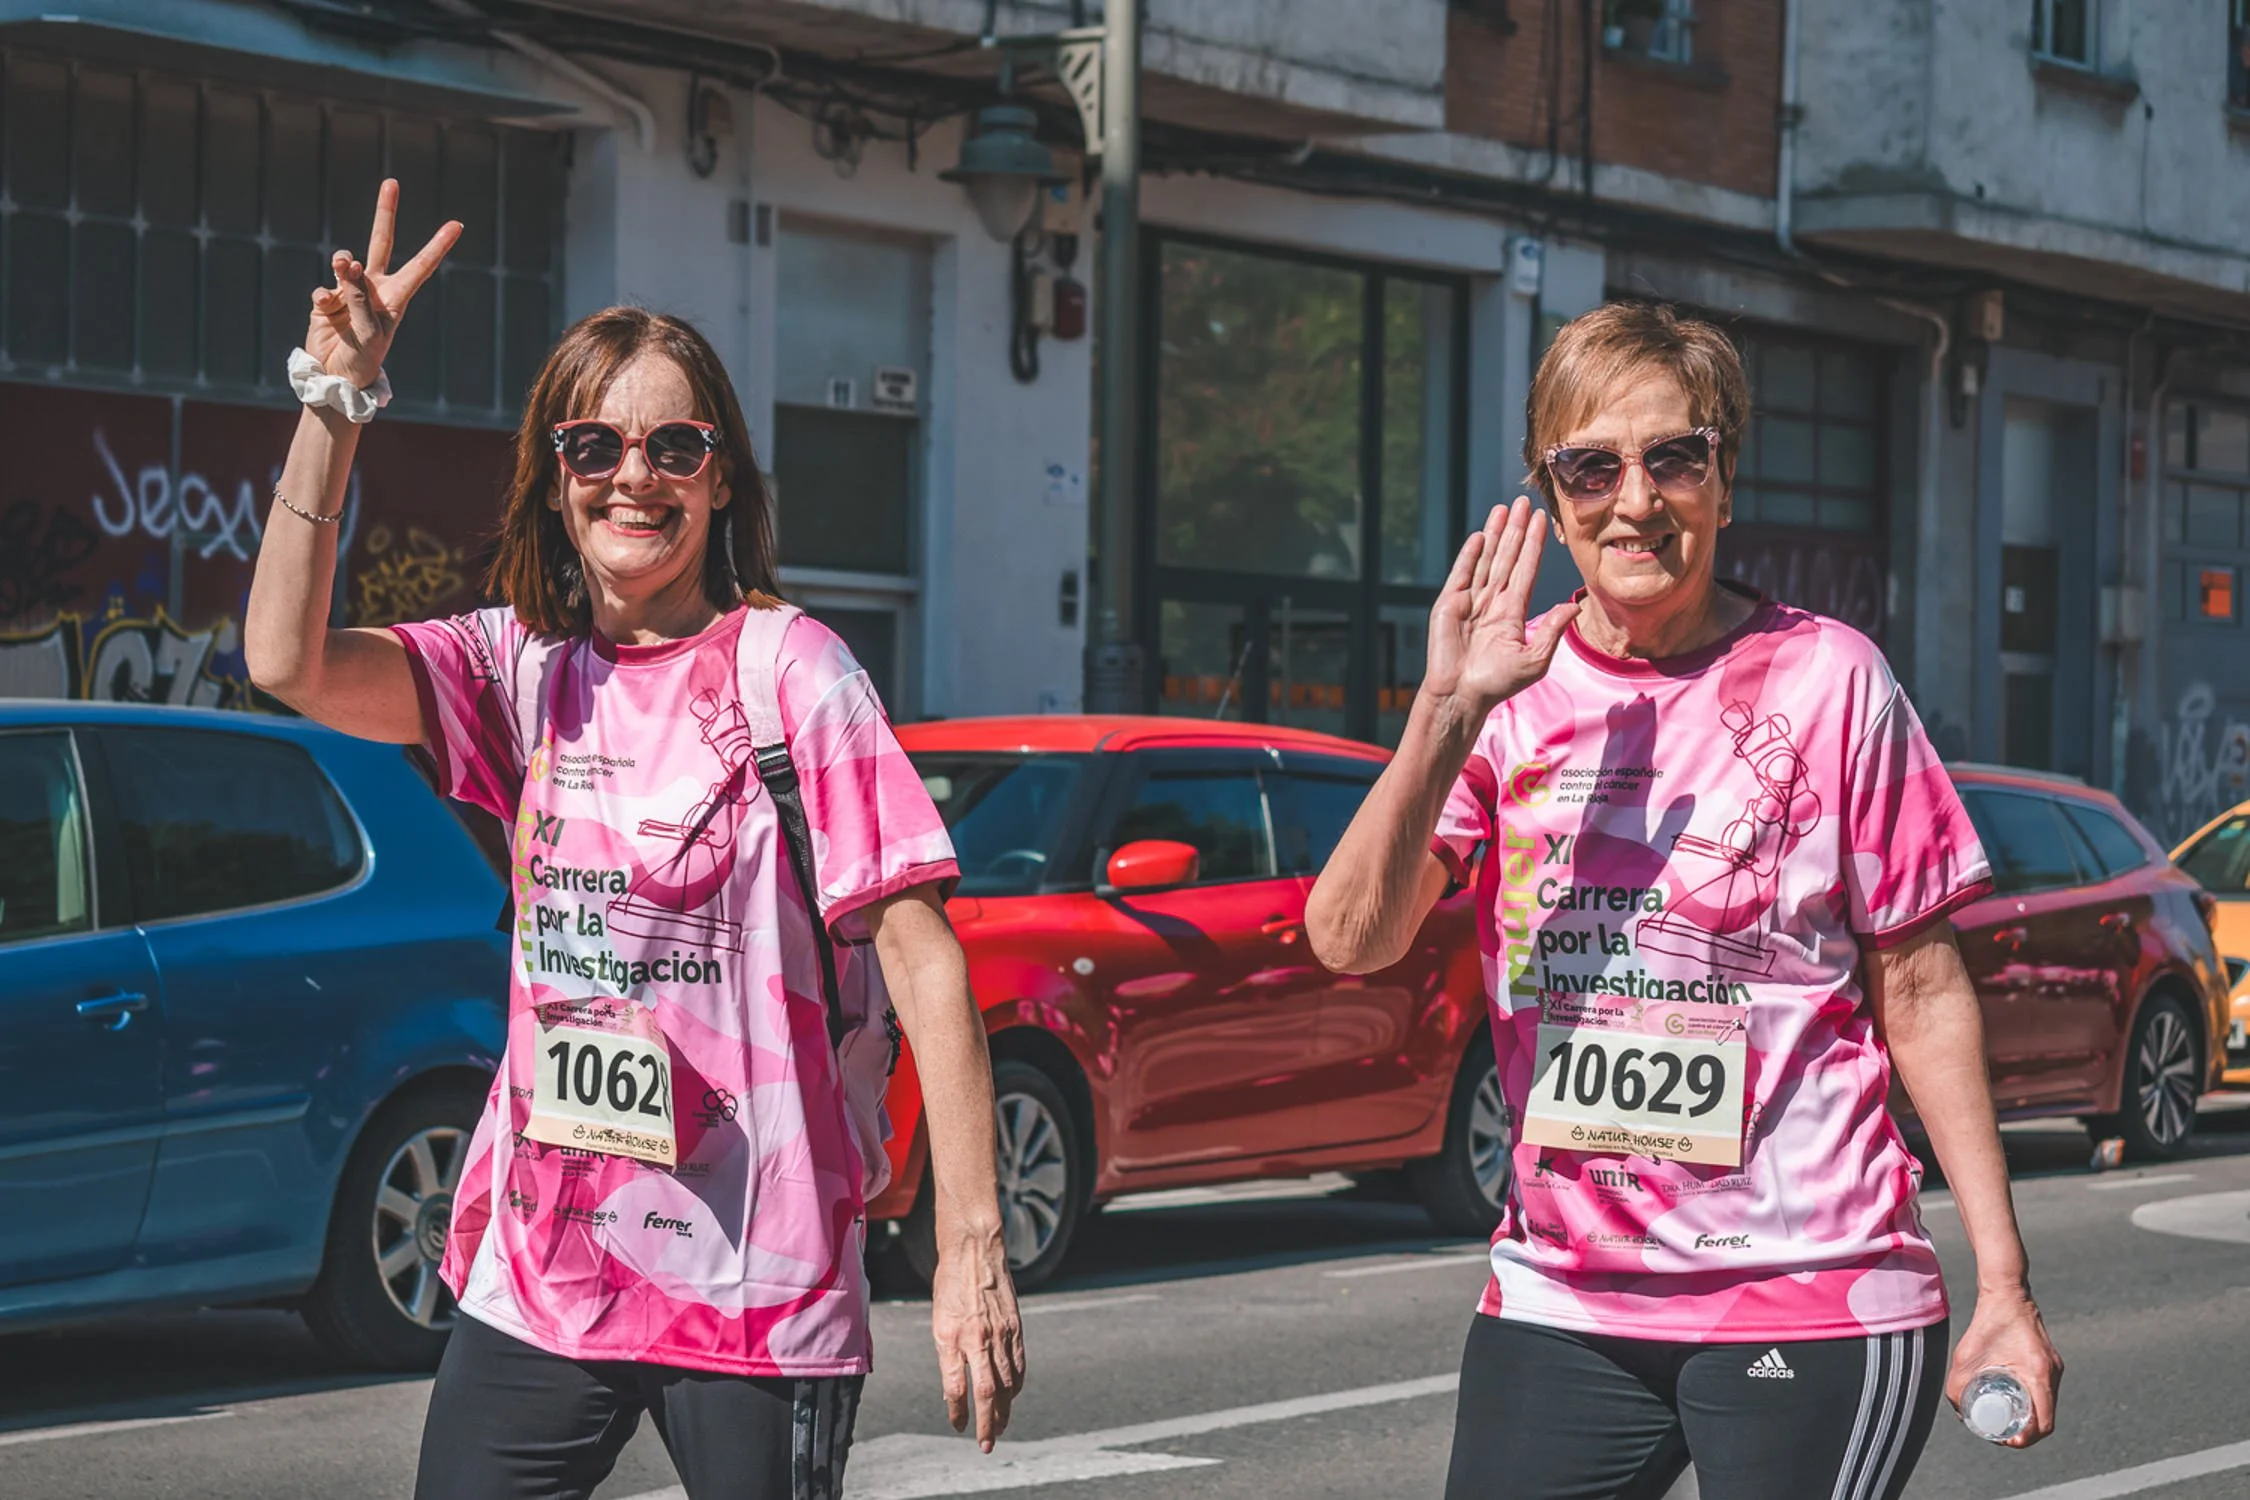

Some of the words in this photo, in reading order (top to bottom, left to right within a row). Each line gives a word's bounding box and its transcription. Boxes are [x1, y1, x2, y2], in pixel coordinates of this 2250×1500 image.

[1559, 781, 1592, 791] contra
[1603, 780, 1640, 791] cáncer
[1561, 767, 1613, 778] asociación
[1615, 767, 1664, 779] española
[1556, 795, 1570, 803] en
[1571, 793, 1584, 803] La
[532, 810, 565, 847] XI
[1543, 833, 1575, 865] XI
[530, 854, 628, 895] Carrera
[1503, 825, 1538, 996] mujer
[1536, 878, 1664, 913] Carrera
[536, 903, 570, 937] por
[577, 903, 604, 937] la
[1537, 926, 1591, 961] por
[1599, 923, 1631, 957] la
[539, 941, 722, 994] Investigación
[1544, 964, 1752, 1006] Investigación
[559, 1003, 593, 1015] Carrera
[1549, 1000, 1561, 1011] XI
[1564, 1003, 1597, 1015] Carrera
[1598, 1007, 1613, 1017] por
[1615, 1007, 1624, 1017] la
[1549, 1041, 1726, 1118] 10629
[1587, 1129, 1631, 1143] NATUR
[1633, 1134, 1676, 1149] HOUSE
[1747, 1367, 1795, 1379] adidas
